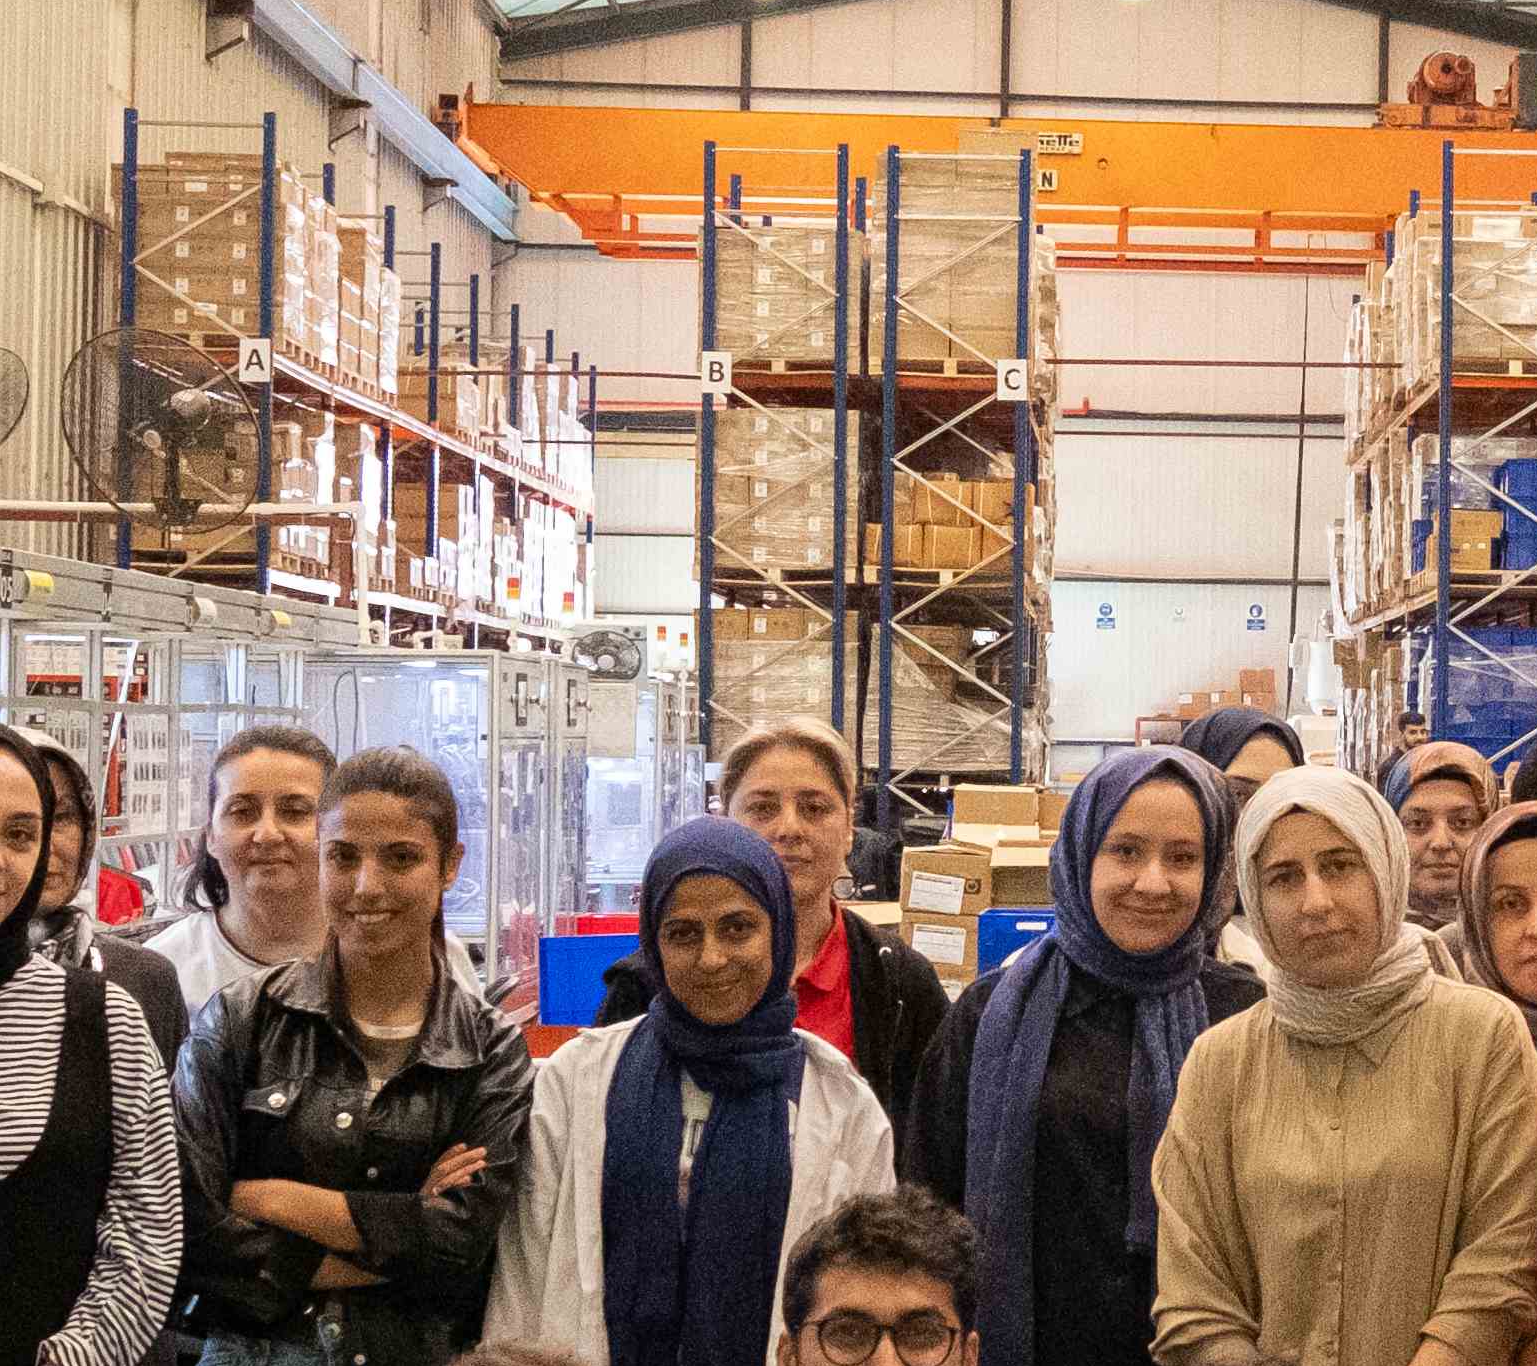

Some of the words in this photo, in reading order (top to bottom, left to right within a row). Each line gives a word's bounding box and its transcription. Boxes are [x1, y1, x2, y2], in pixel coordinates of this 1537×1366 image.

[245, 349, 265, 371] A
[709, 361, 724, 382] B
[1004, 368, 1020, 391] C
